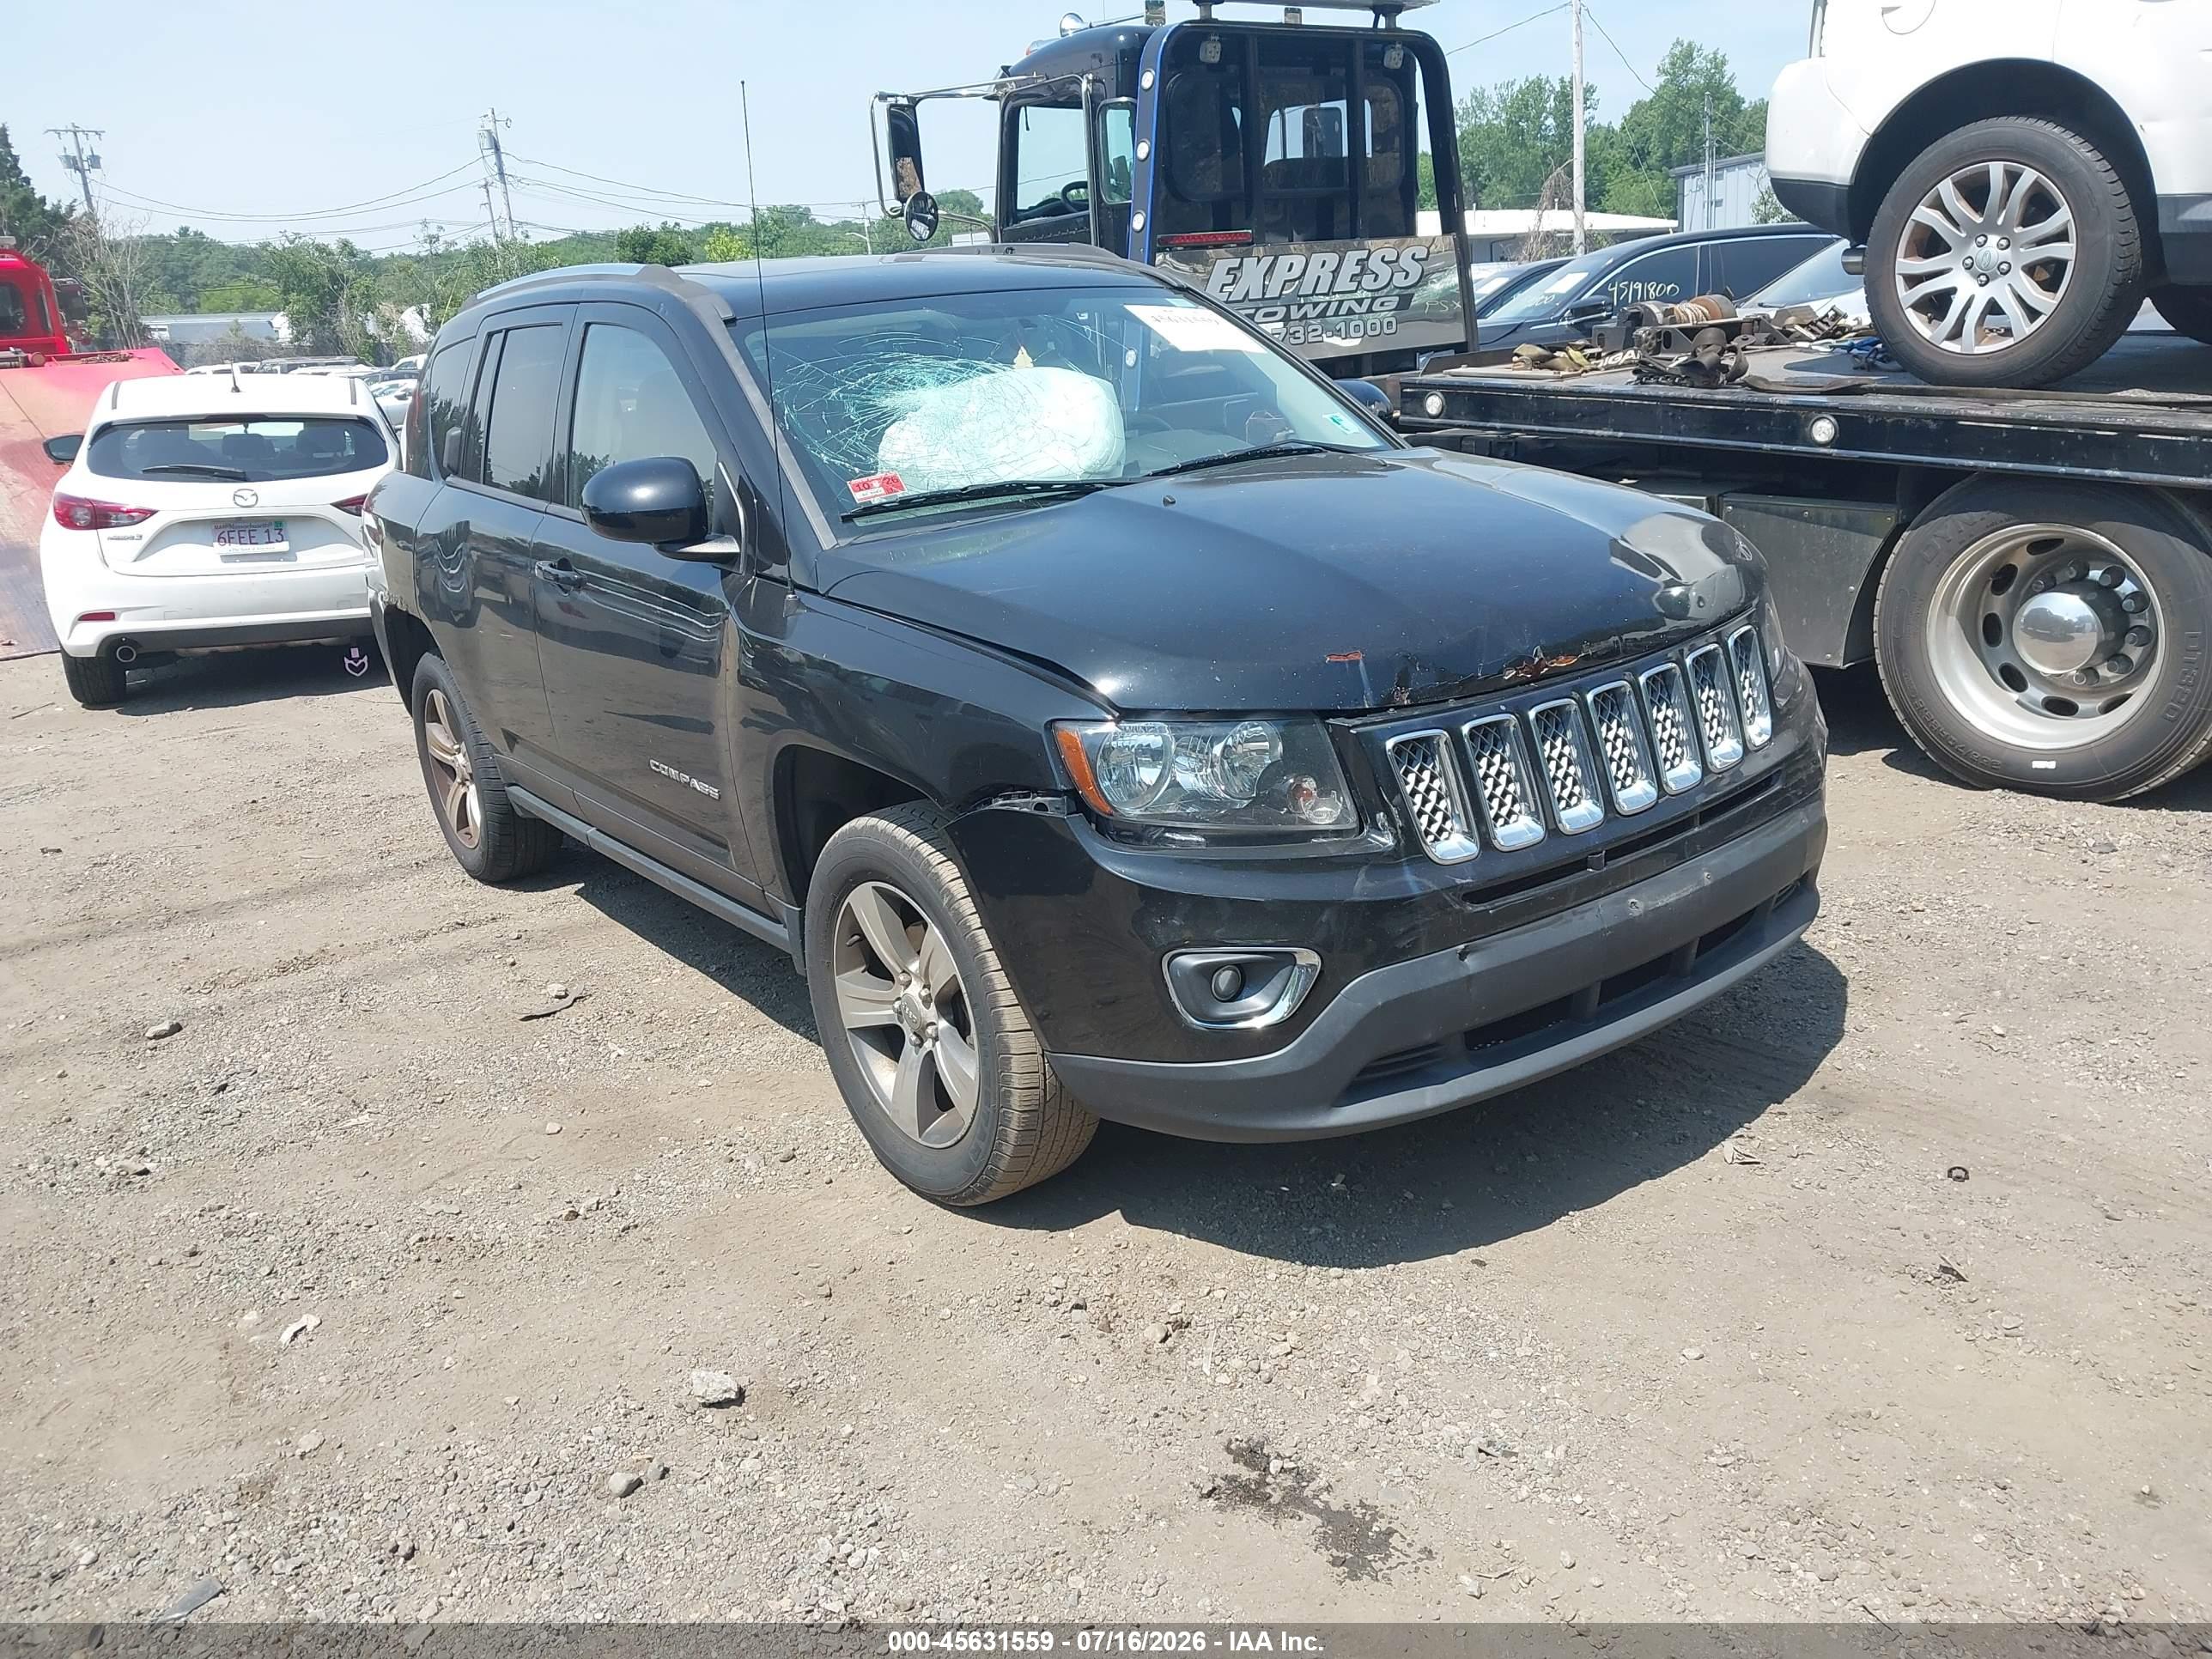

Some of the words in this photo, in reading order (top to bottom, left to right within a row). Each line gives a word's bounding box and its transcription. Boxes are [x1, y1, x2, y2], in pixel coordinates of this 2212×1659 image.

[1205, 245, 1429, 302] EXPRESS
[1607, 280, 1680, 307] 45191800
[1271, 316, 1398, 345] 732-1000
[217, 529, 258, 546] 6FEE
[264, 528, 284, 544] 13
[649, 758, 721, 800] COMPASS
